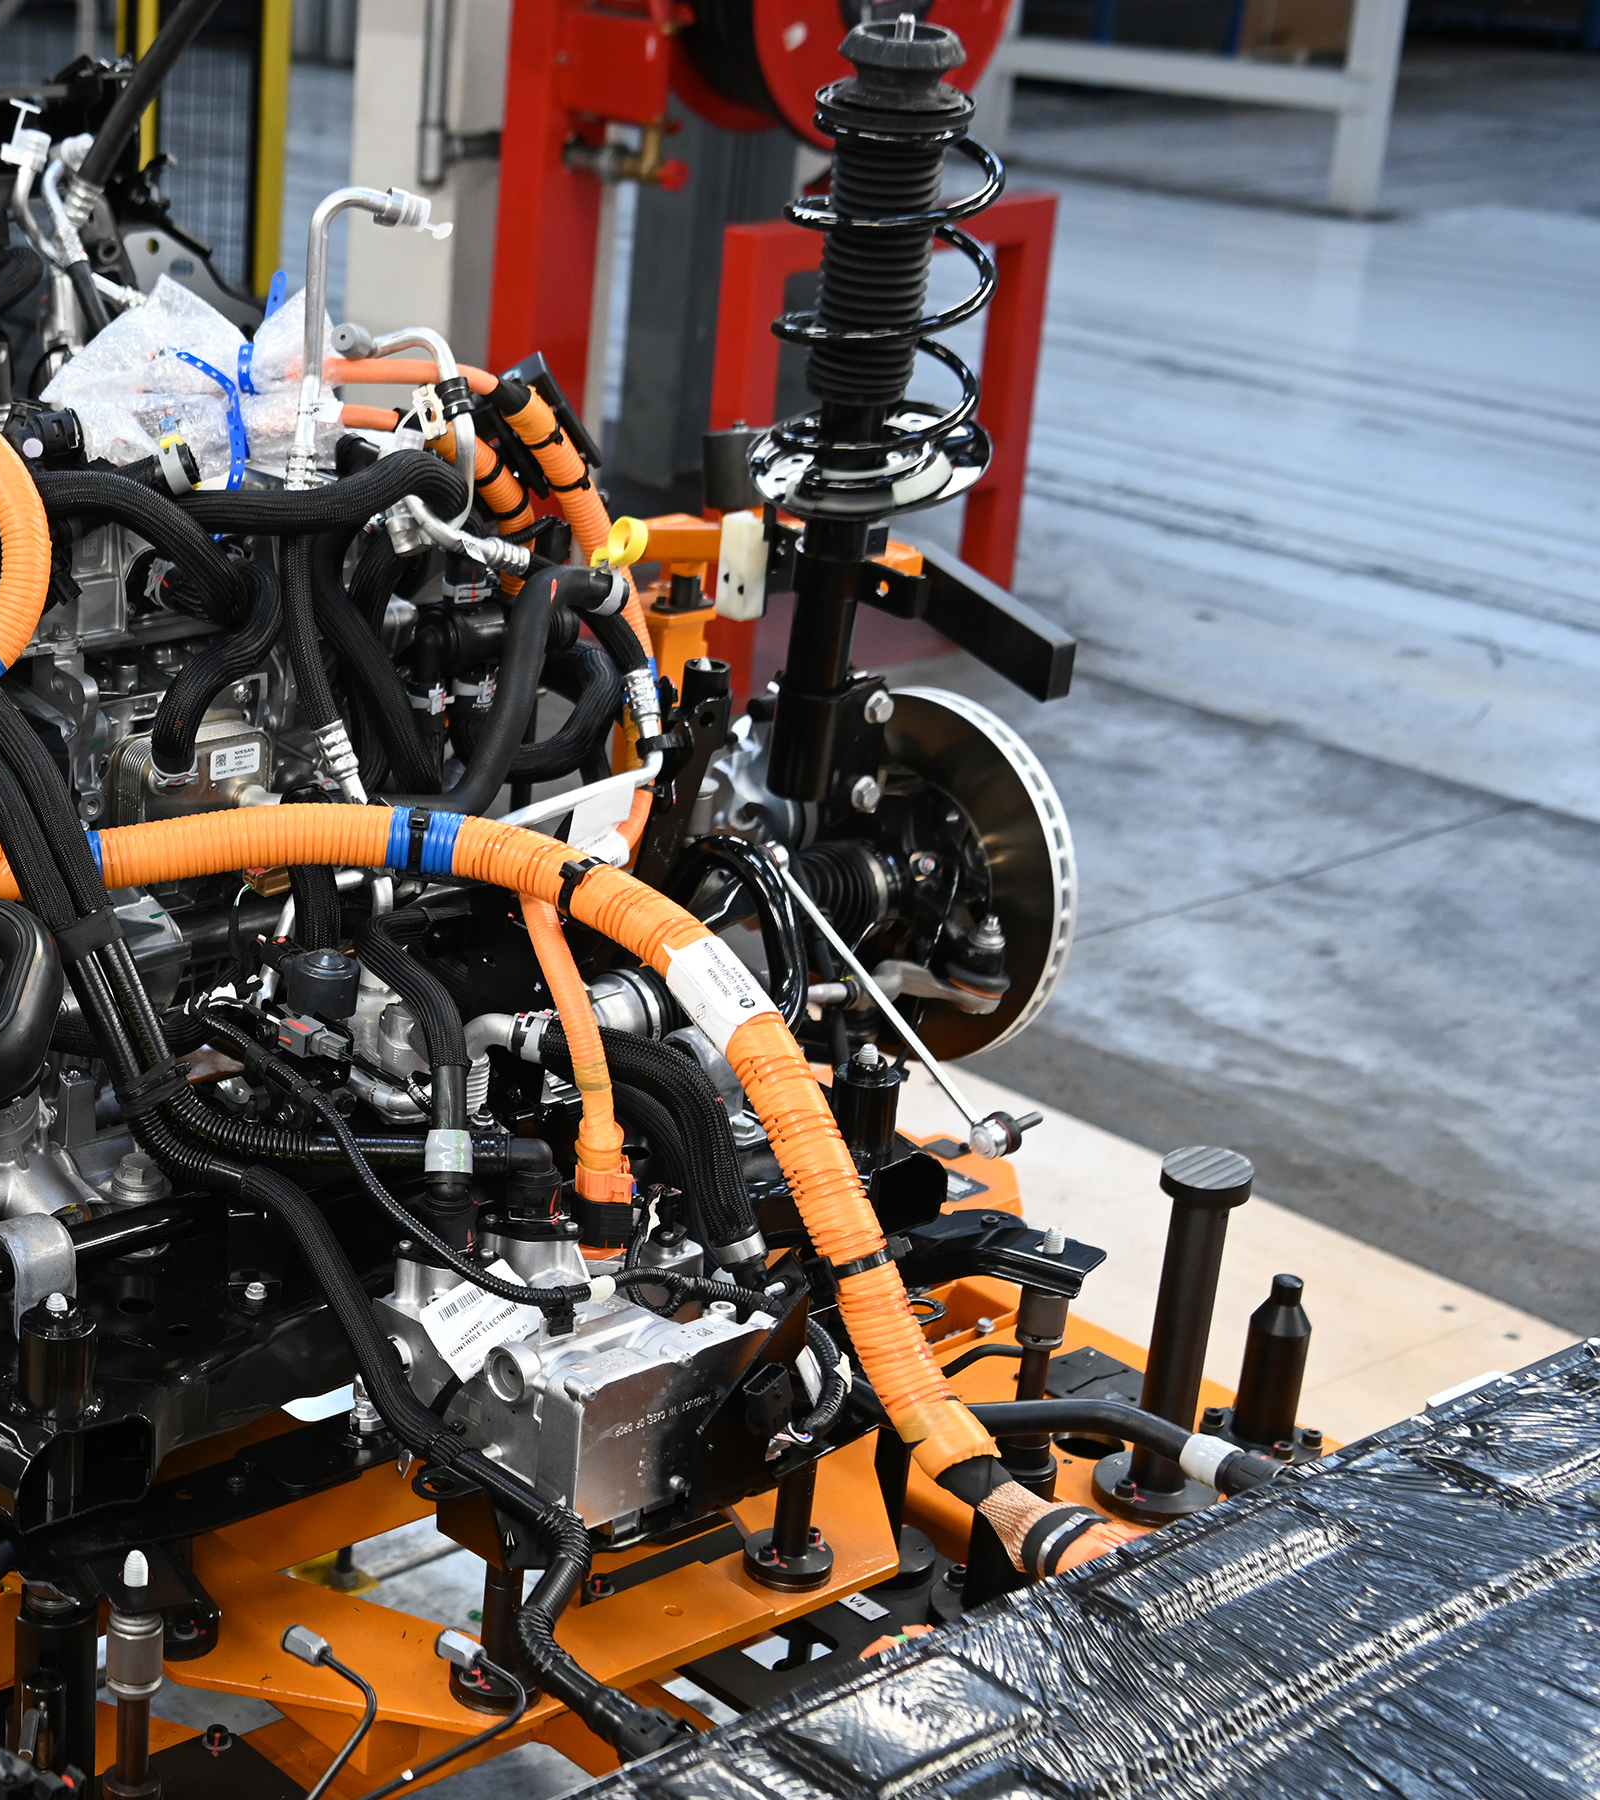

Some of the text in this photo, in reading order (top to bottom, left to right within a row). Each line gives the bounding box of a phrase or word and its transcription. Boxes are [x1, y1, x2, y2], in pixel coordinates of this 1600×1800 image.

[234, 747, 255, 755] NISSAN
[703, 942, 737, 985] CORPORATION
[450, 1330, 482, 1358] CONTROLE
[482, 1303, 519, 1333] ELECTRIQUE
[669, 1406, 677, 1416] IN
[614, 1422, 634, 1437] DROP
[635, 1418, 645, 1429] OF
[849, 1596, 866, 1608] V4
